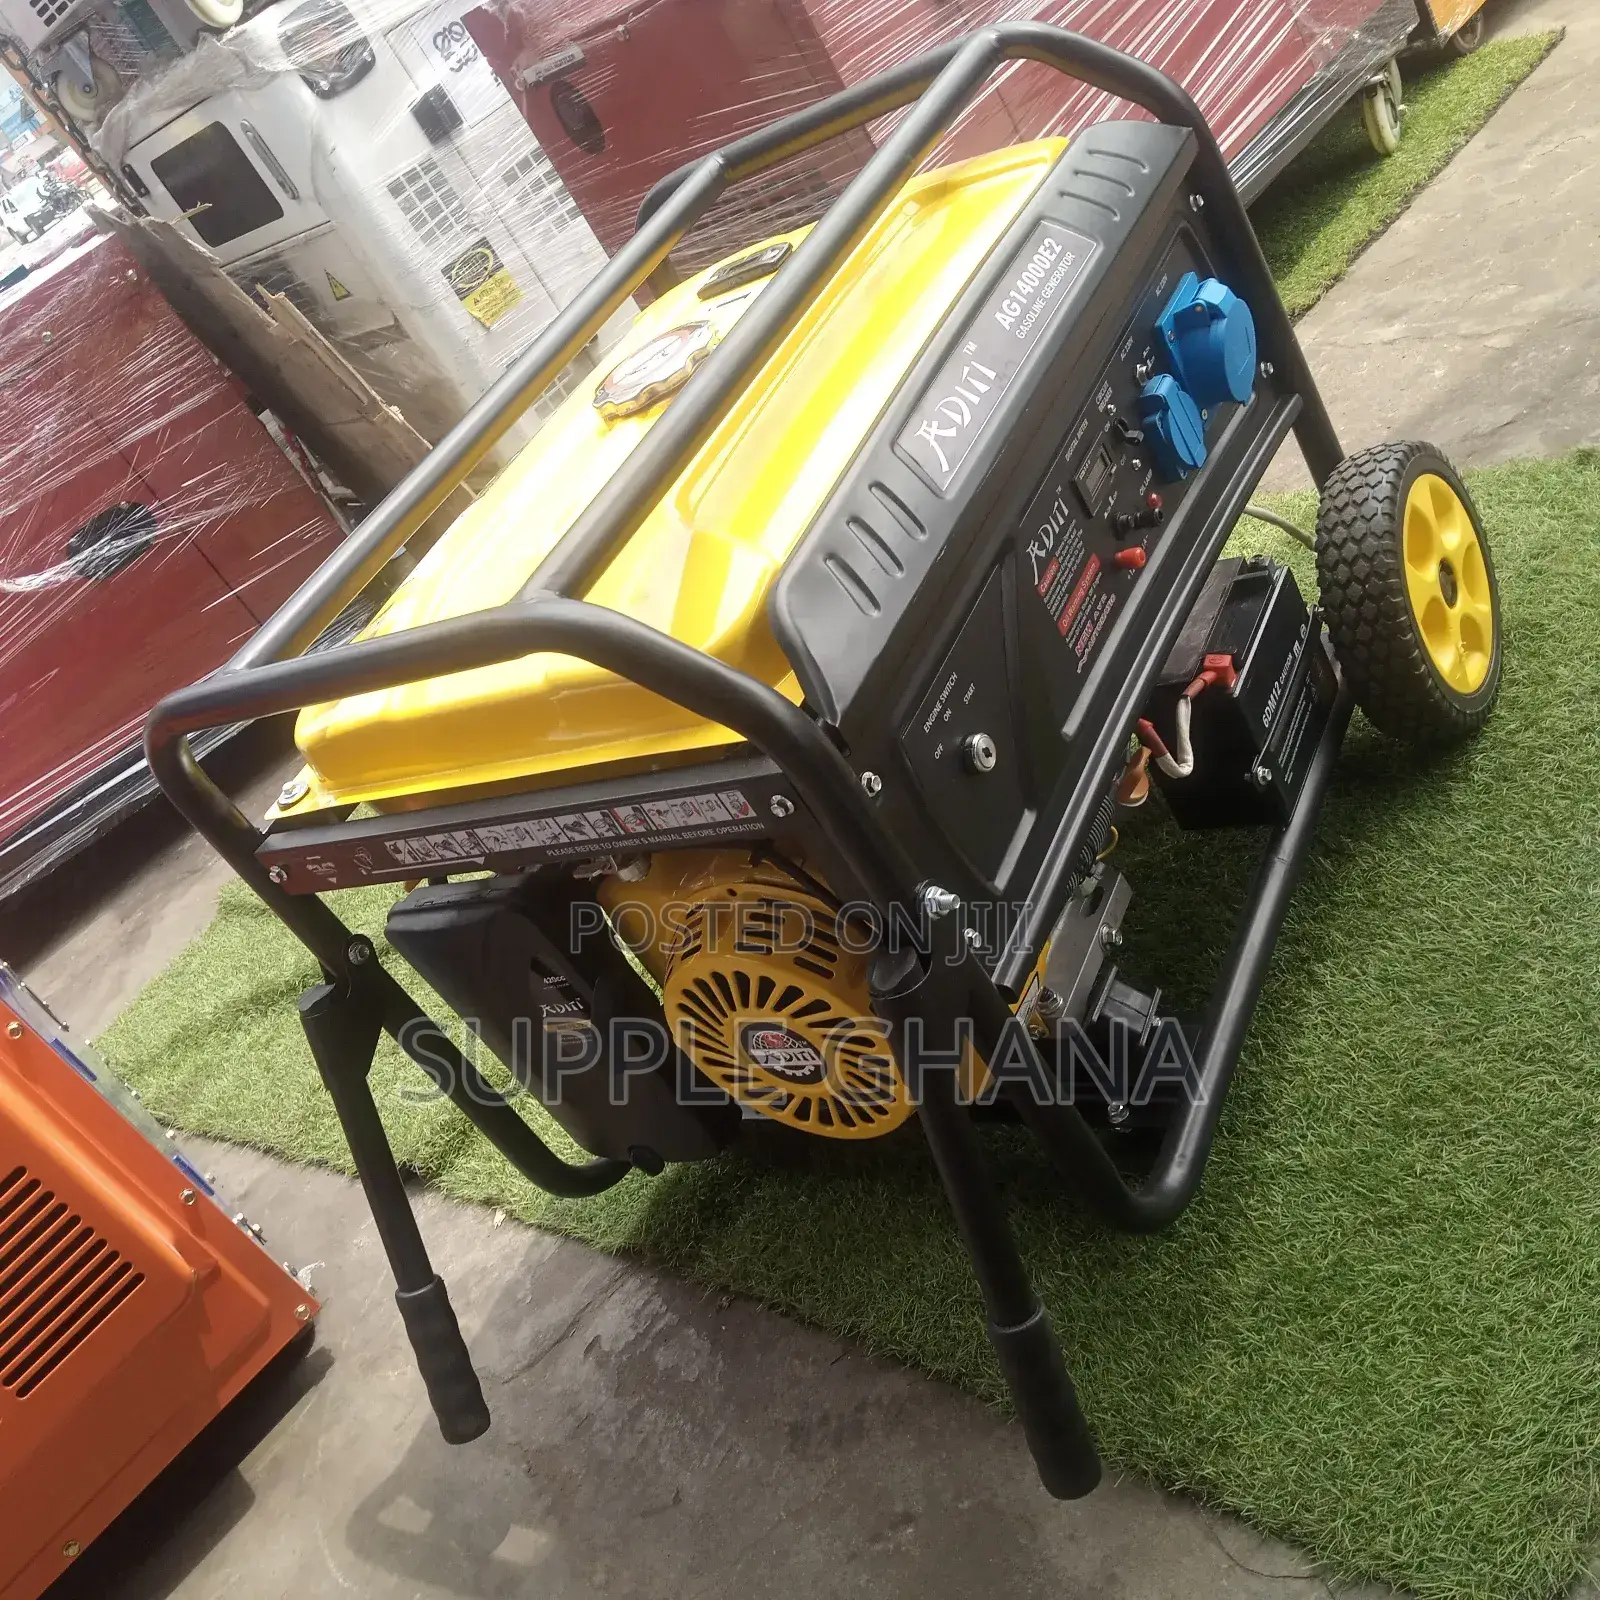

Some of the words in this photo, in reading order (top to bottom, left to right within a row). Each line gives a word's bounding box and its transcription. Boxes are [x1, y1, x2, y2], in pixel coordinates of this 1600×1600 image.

[994, 237, 1063, 330] AG14000E2
[1016, 297, 1046, 339] GASOLINE
[1041, 251, 1076, 298] GENERATOR
[963, 340, 977, 356] TM
[1095, 380, 1109, 405] CIRCUIT
[1098, 386, 1113, 412] BREAKER
[1065, 437, 1079, 462] DIGITAL
[1077, 418, 1089, 440] METER
[1143, 468, 1153, 486] LAMP
[1068, 588, 1084, 616] Warning
[1082, 563, 1095, 588] System
[1075, 620, 1093, 656] NEW
[923, 700, 942, 733] ENGINE
[940, 672, 958, 703] SWITCH
[963, 683, 976, 704] START
[1262, 681, 1282, 728] 6DM12
[1279, 652, 1294, 685] CAUTION
[943, 708, 952, 721] ON
[934, 743, 944, 759] OFF
[546, 847, 576, 856] PLEASE
[575, 844, 602, 854] REFER
[601, 842, 612, 850] TO
[649, 834, 683, 844] MANUAL
[683, 828, 717, 839] BEFORE
[717, 822, 765, 835] OPERATION
